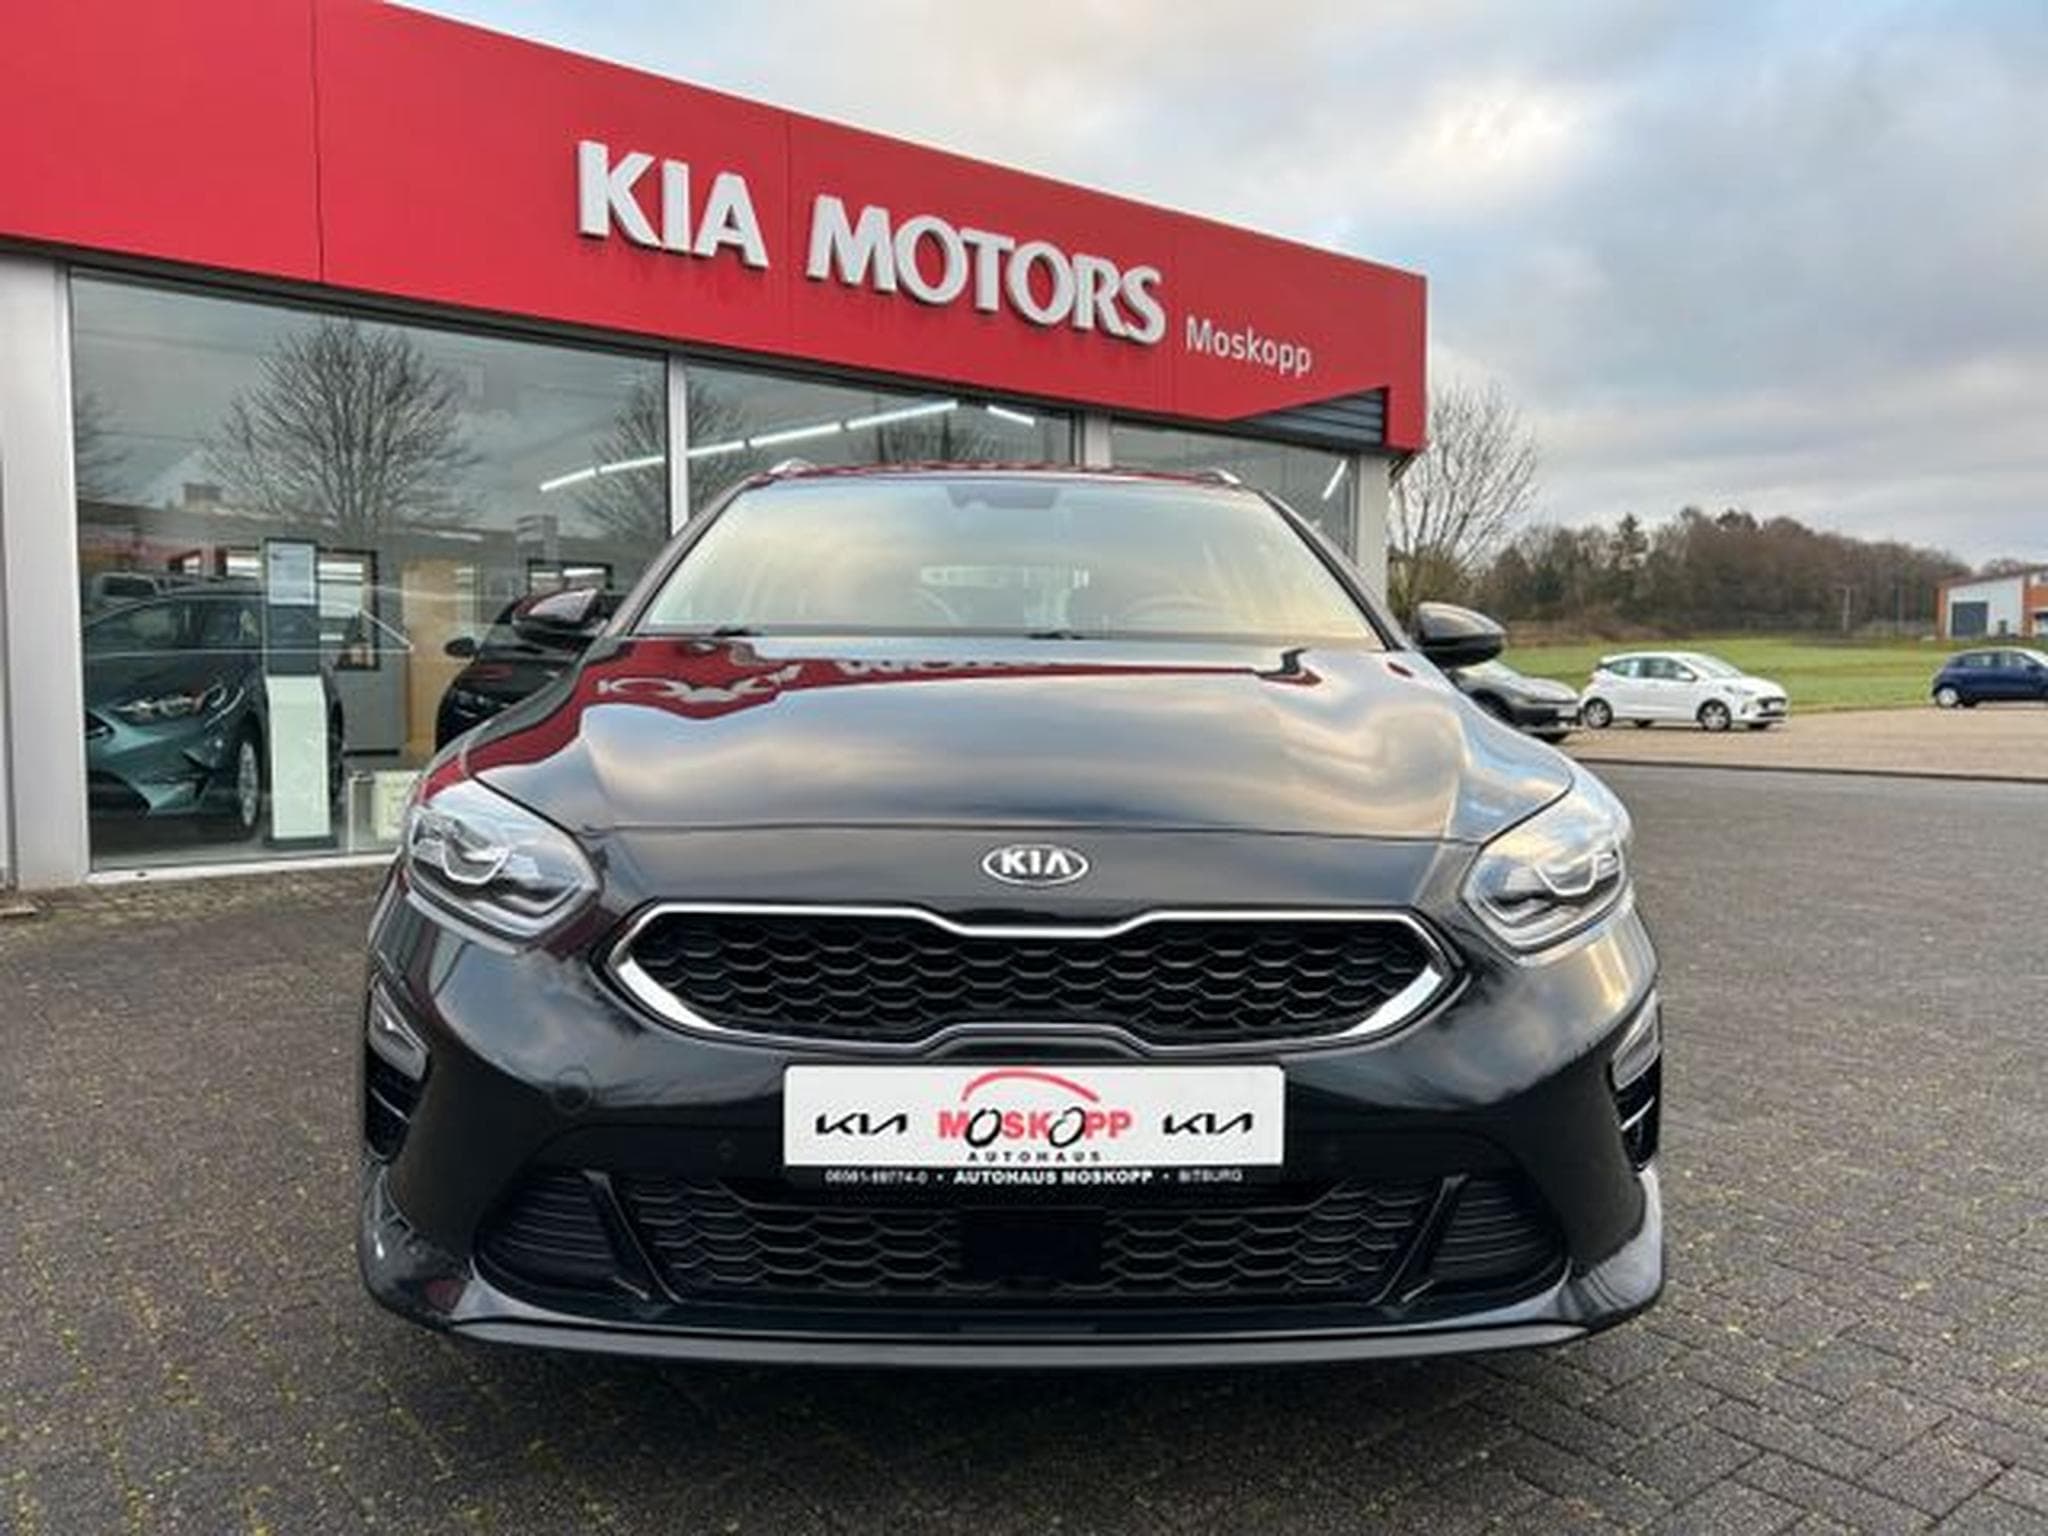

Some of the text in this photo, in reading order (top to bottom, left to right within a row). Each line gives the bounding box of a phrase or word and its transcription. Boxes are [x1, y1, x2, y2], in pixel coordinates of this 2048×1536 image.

[579, 140, 1167, 345] KIA MOTORS
[1186, 315, 1312, 378] Moskopp
[1001, 849, 1071, 875] KIA
[815, 1112, 908, 1135] KIA
[938, 1106, 1133, 1149] MOSKOPP
[1162, 1112, 1254, 1135] KIA
[967, 1151, 1101, 1162] AUTOHAUS
[953, 1169, 1057, 1185] AUTOHAUS
[1061, 1169, 1153, 1185] MOSKOPP
